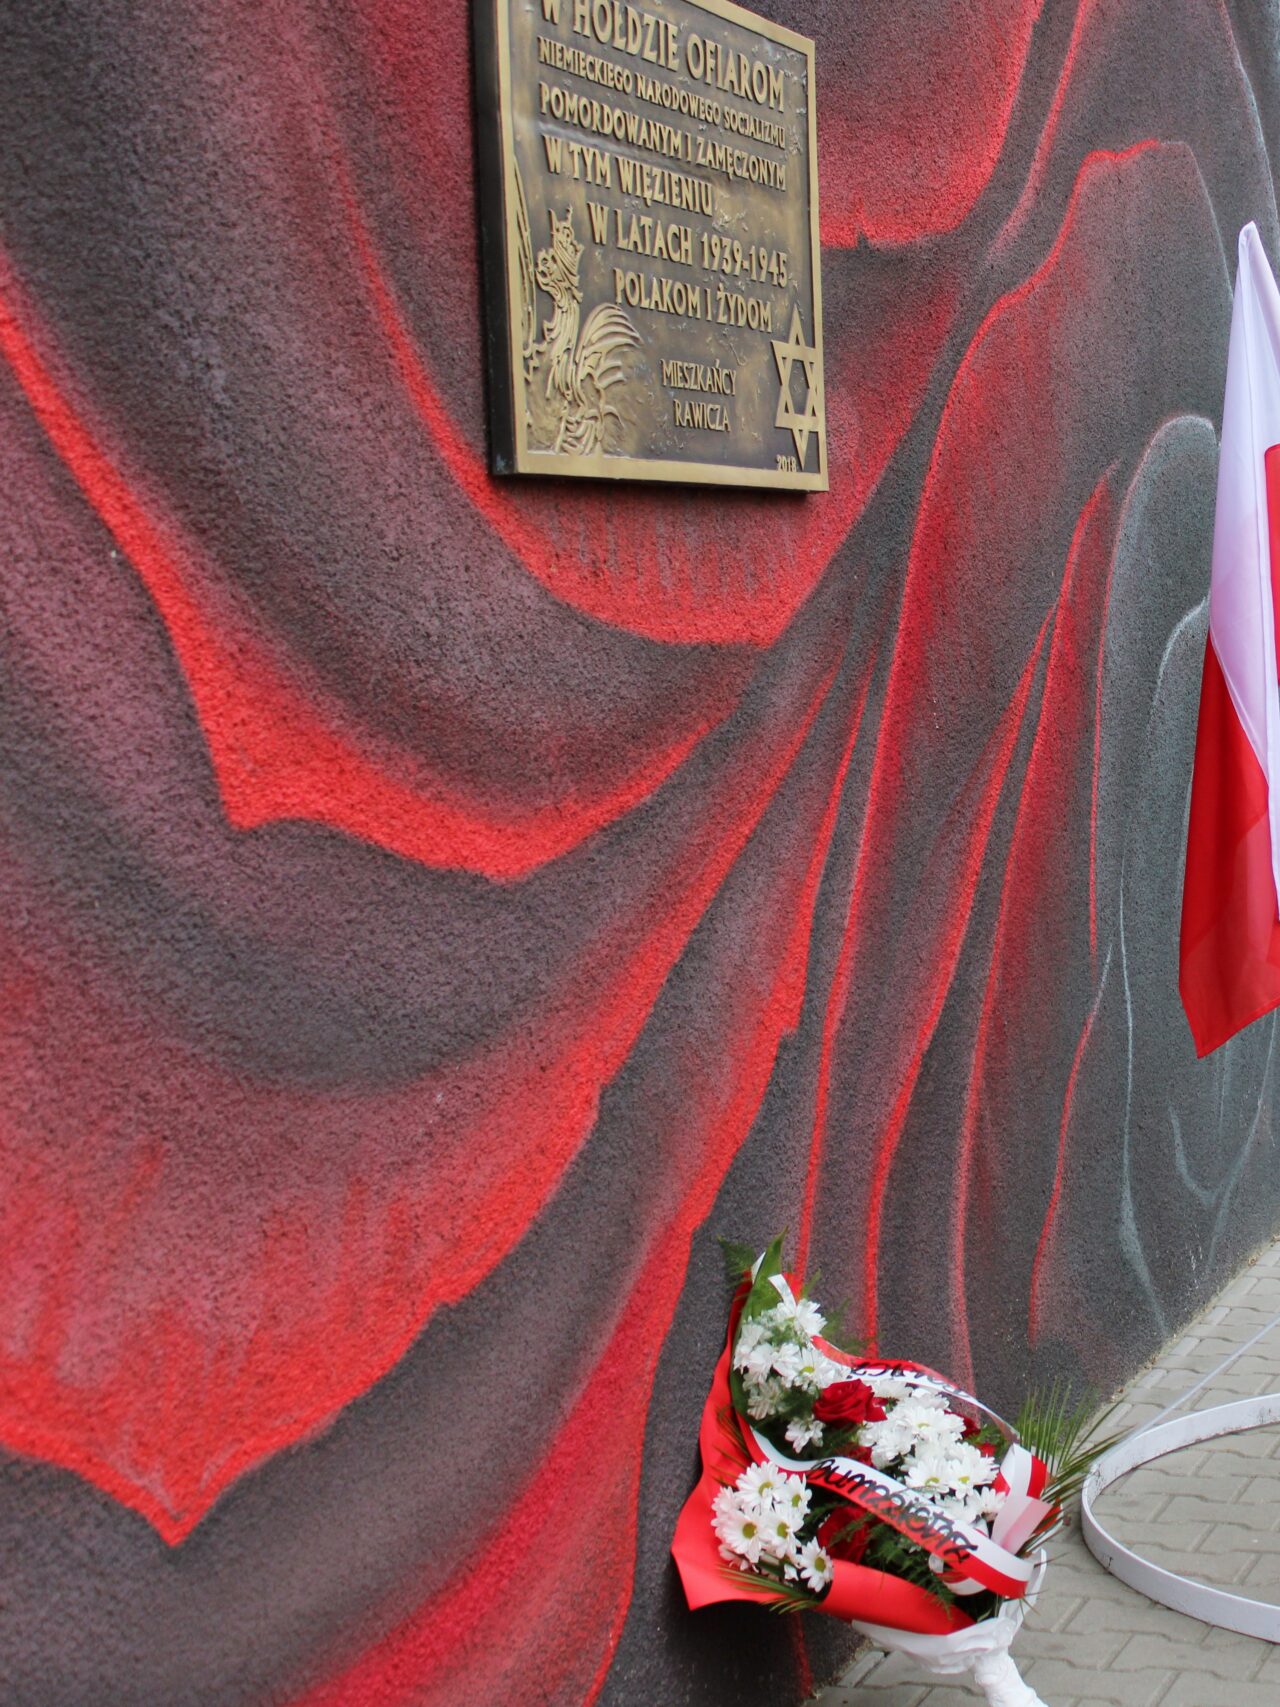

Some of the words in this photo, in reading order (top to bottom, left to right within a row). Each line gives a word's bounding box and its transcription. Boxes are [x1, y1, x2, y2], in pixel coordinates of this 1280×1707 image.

[537, 36, 633, 96] NIEMIECKIEGO
[635, 72, 721, 125] NARODOWEGO
[723, 106, 786, 149] SOCJALIZMU
[573, 0, 680, 72] HOŁDZIE
[686, 34, 785, 112] OFIAROM
[539, 82, 683, 157] POMORDOWANYM
[685, 133, 693, 163] I
[696, 137, 787, 192] ZAMĘCZONYM
[542, 134, 562, 174] W
[567, 141, 612, 188] TYM
[616, 156, 713, 217] WIĘZIENIU
[587, 202, 609, 245] W
[615, 209, 693, 266] LATACH
[701, 232, 788, 288] 1939-1945
[613, 268, 700, 319] POLAKOM
[705, 288, 712, 321] I
[716, 284, 772, 333] ŻYDOM
[660, 359, 737, 397] MIESZKAŃCY
[674, 399, 732, 432] RAWICZA
